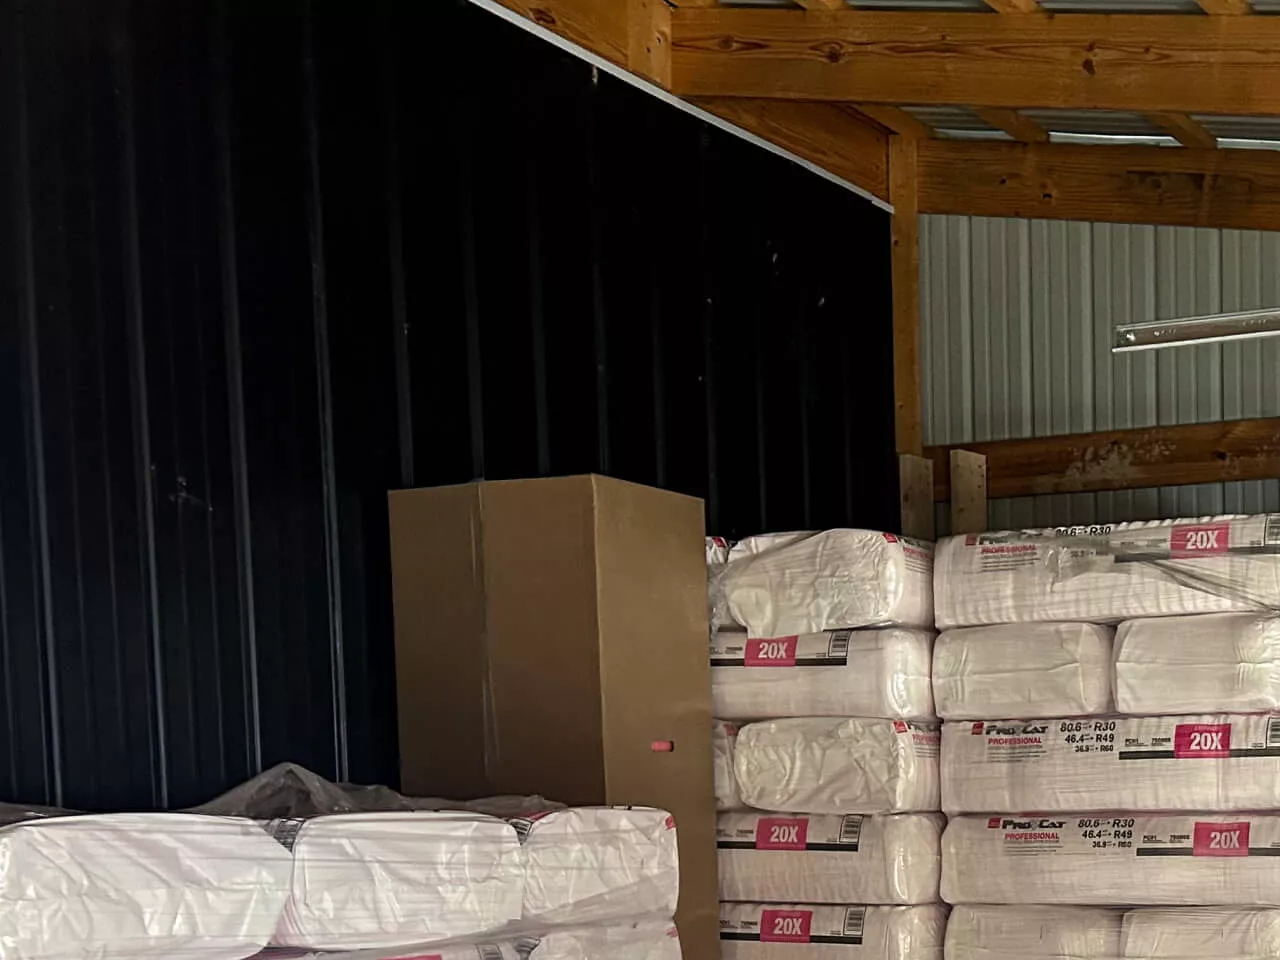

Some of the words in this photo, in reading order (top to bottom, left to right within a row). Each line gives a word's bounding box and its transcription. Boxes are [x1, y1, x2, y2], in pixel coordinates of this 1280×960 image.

[1089, 527, 1111, 536] R30
[1186, 531, 1219, 549] 20X
[759, 642, 788, 659] 20X
[1060, 722, 1081, 732] 80.6
[1094, 722, 1116, 731] R30
[1065, 734, 1084, 743] 46.4
[1096, 734, 1114, 742] R49
[1190, 733, 1222, 750] 20X
[1078, 820, 1099, 828] 80.6
[1112, 819, 1135, 828] R30
[770, 825, 798, 843] 20X
[1082, 830, 1101, 838] 46.4
[1114, 830, 1132, 838] R49
[1210, 831, 1240, 849] 20X
[773, 918, 802, 935] 20X
